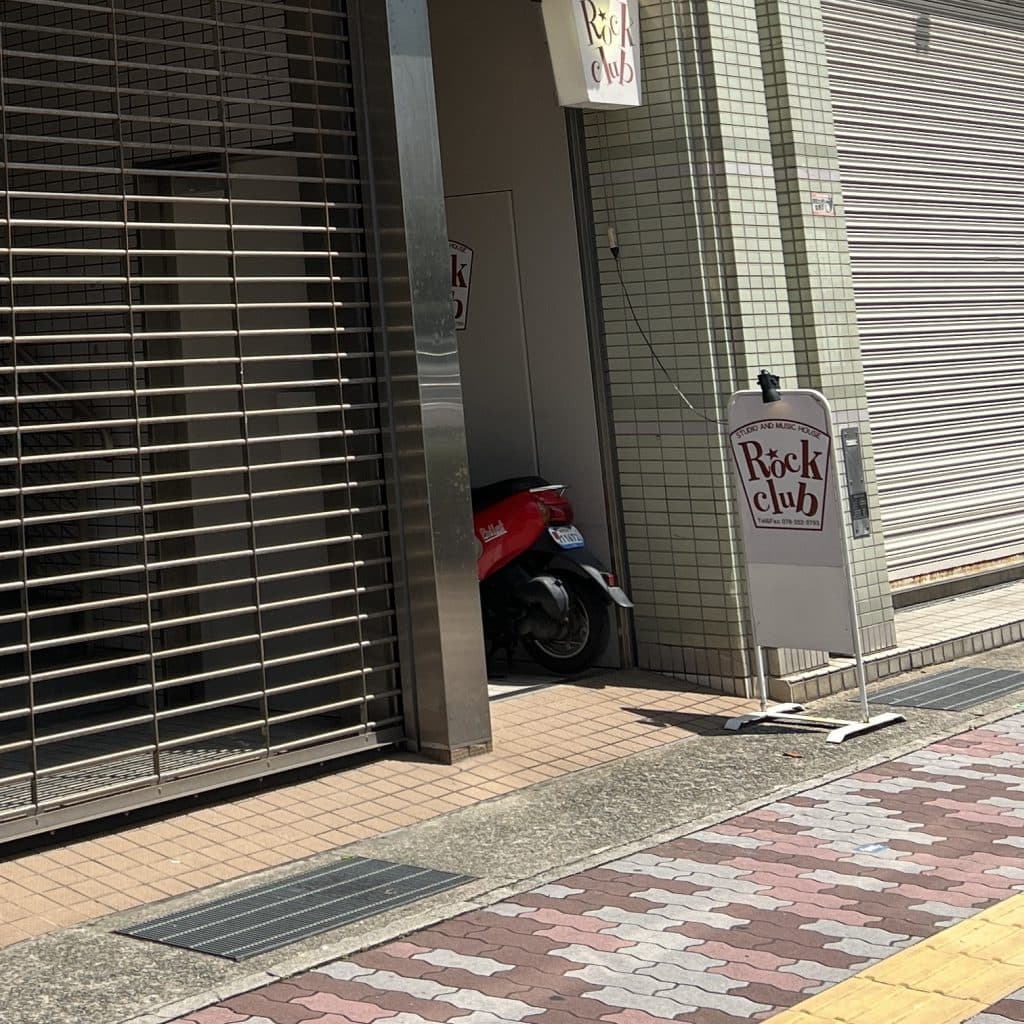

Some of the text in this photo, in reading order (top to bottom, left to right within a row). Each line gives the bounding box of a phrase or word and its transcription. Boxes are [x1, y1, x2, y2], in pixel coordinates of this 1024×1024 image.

[580, 0, 636, 48] Rock
[591, 46, 634, 87] club
[735, 422, 822, 440] STUDIO AND MUSIC HOUSE
[738, 439, 823, 481] Rock
[753, 479, 819, 517] club
